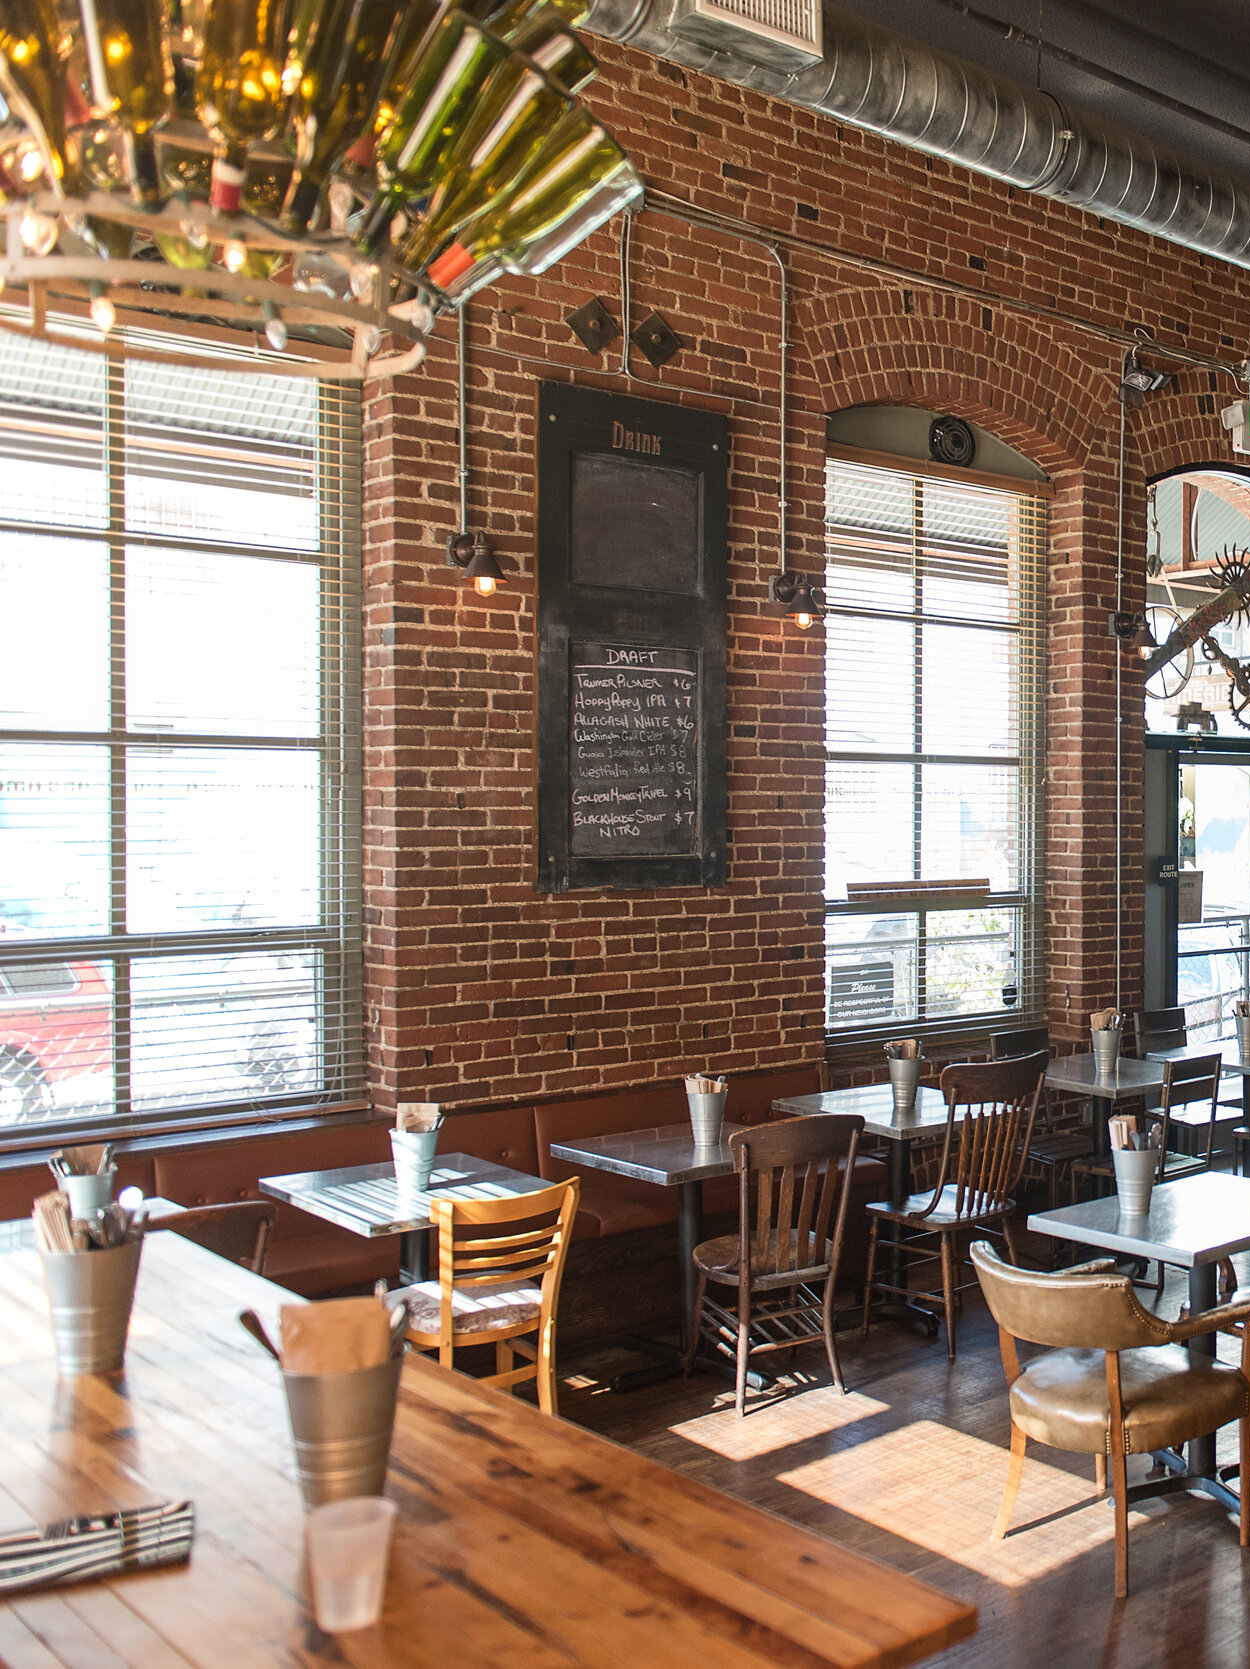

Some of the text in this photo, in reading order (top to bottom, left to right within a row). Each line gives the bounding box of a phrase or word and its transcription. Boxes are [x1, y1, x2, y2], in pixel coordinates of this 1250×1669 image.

[605, 648, 658, 665] DRAFT
[616, 673, 662, 689] PILSNER
[647, 693, 667, 707] IPA
[574, 711, 694, 729] ALLAGASH WHITE $6
[574, 728, 620, 744] Washington
[640, 730, 665, 742] Cider
[672, 729, 689, 743] $7
[578, 746, 605, 759] Guava
[648, 744, 666, 756] IPA
[670, 744, 687, 758] $8
[579, 763, 629, 779] Westfalia
[633, 760, 650, 775] Red
[674, 787, 691, 801] $9
[635, 809, 666, 824] STOUT
[674, 810, 695, 825] $7
[600, 825, 640, 838] NITRO
[850, 983, 877, 993] Please
